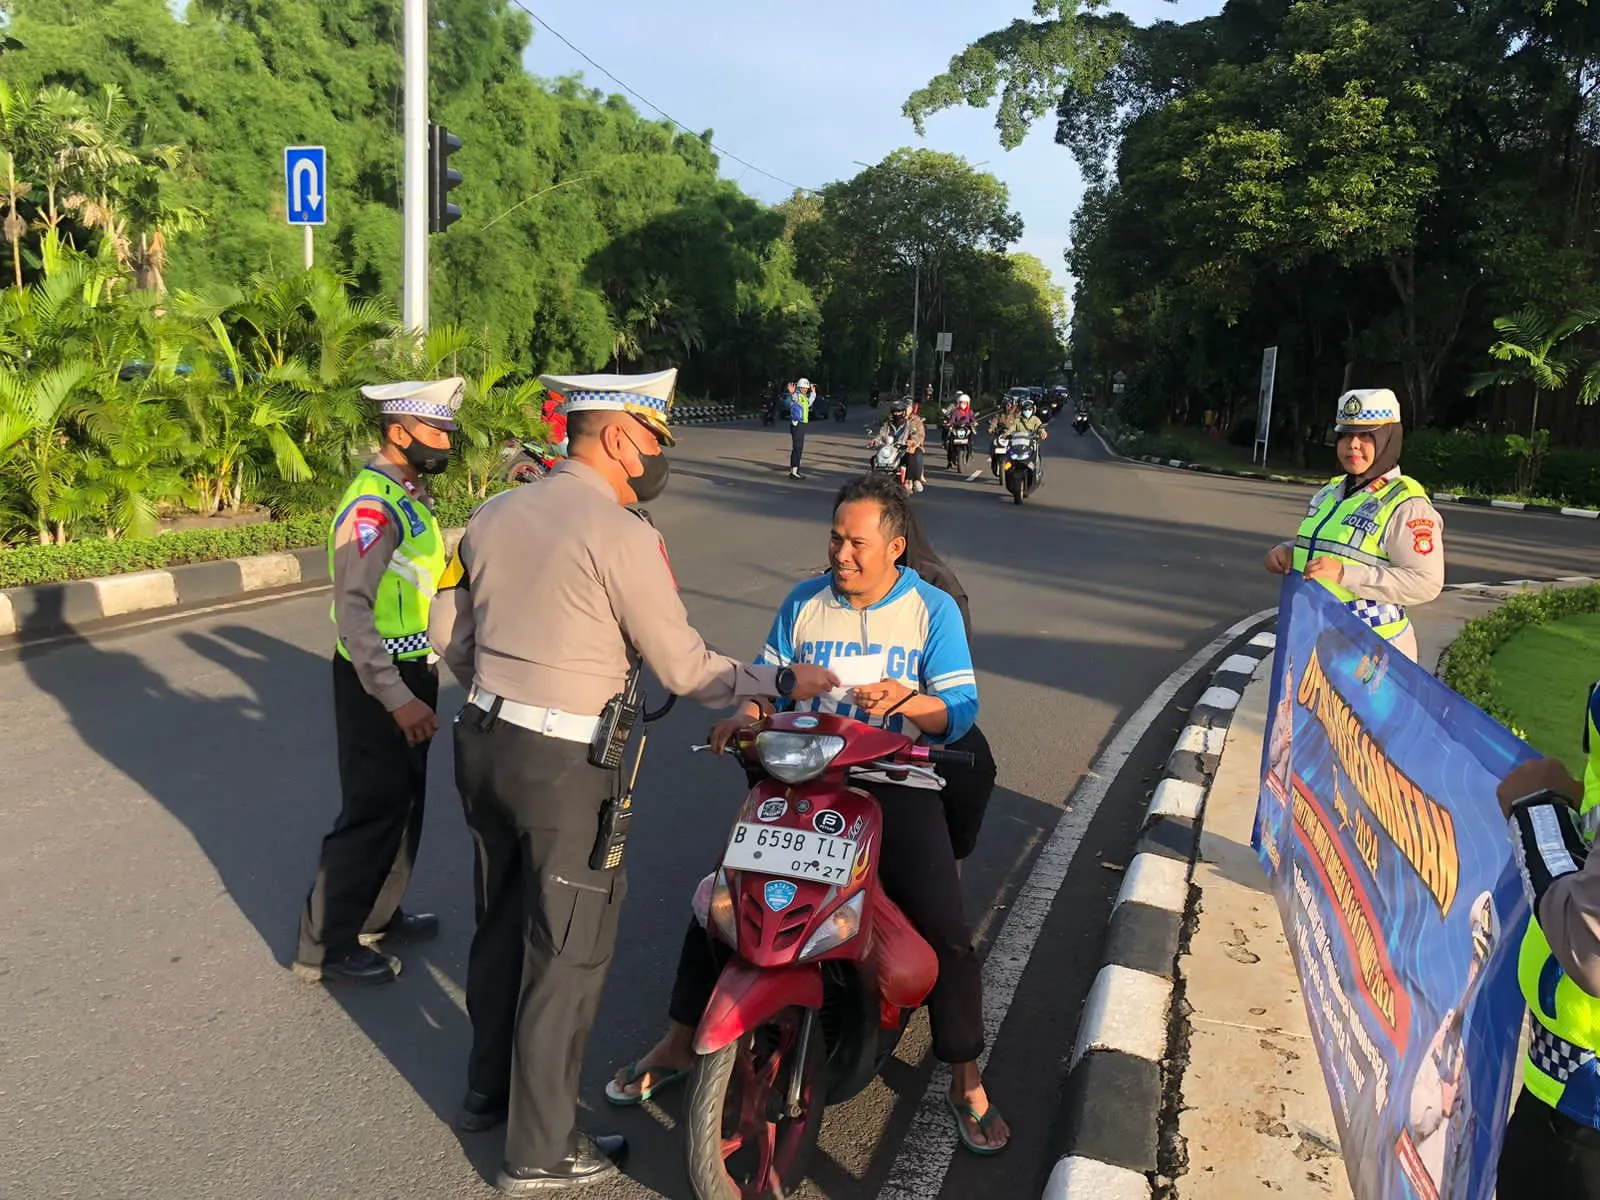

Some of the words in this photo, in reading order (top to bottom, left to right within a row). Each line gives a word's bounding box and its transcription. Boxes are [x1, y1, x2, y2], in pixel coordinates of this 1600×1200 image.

[800, 639, 921, 681] CHGO
[734, 826, 747, 843] B
[757, 829, 805, 851] 6598
[817, 837, 852, 859] TLT
[1355, 808, 1378, 881] 2024
[1371, 964, 1396, 1029] 2024
